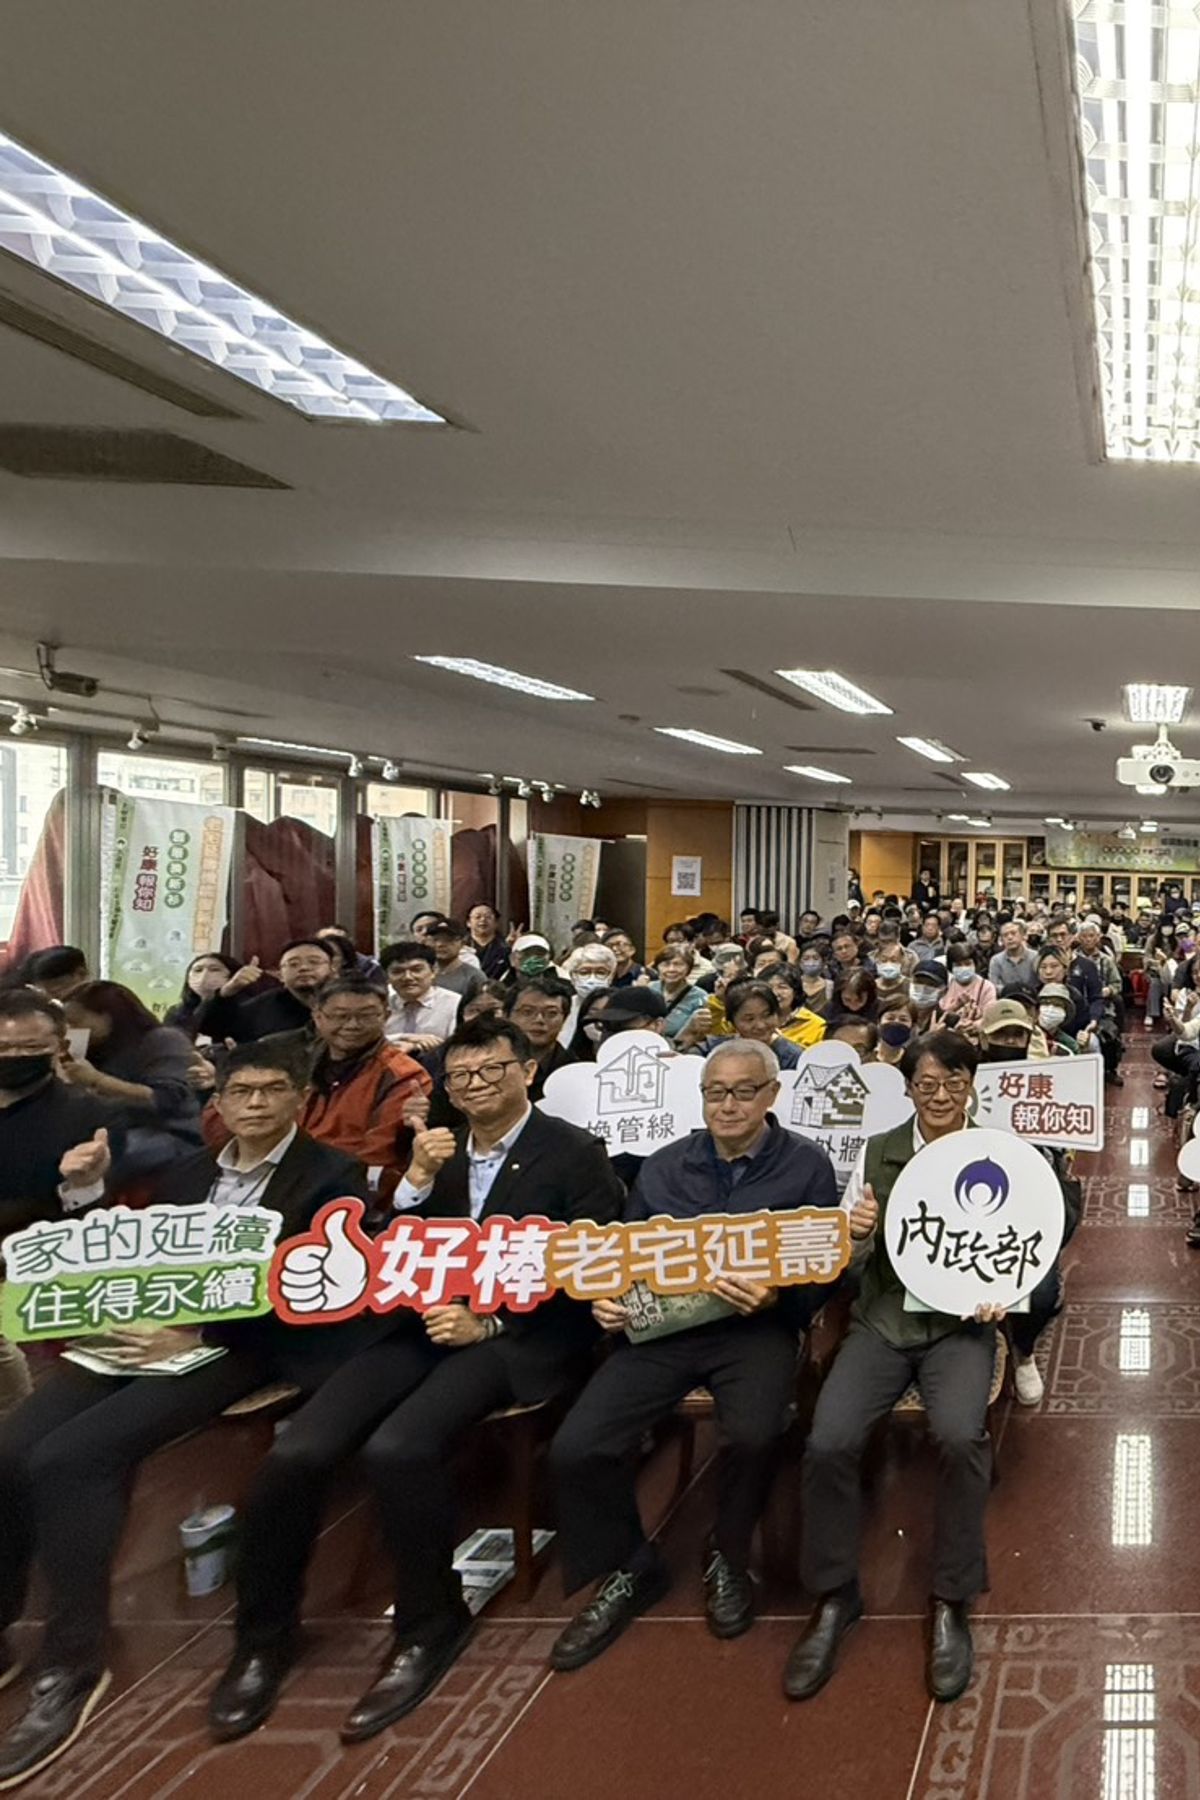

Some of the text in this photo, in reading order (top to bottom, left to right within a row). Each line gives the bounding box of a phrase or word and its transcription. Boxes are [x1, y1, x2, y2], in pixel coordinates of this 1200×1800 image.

[998, 1071, 1053, 1099] 好康
[1012, 1103, 1093, 1132] 報你知
[12, 1211, 272, 1275] 家的延續
[374, 1224, 550, 1304] 好棒
[553, 1216, 840, 1292] 老宅延壽
[897, 1201, 1043, 1289] 內政部
[21, 1266, 256, 1330] 住得永續
